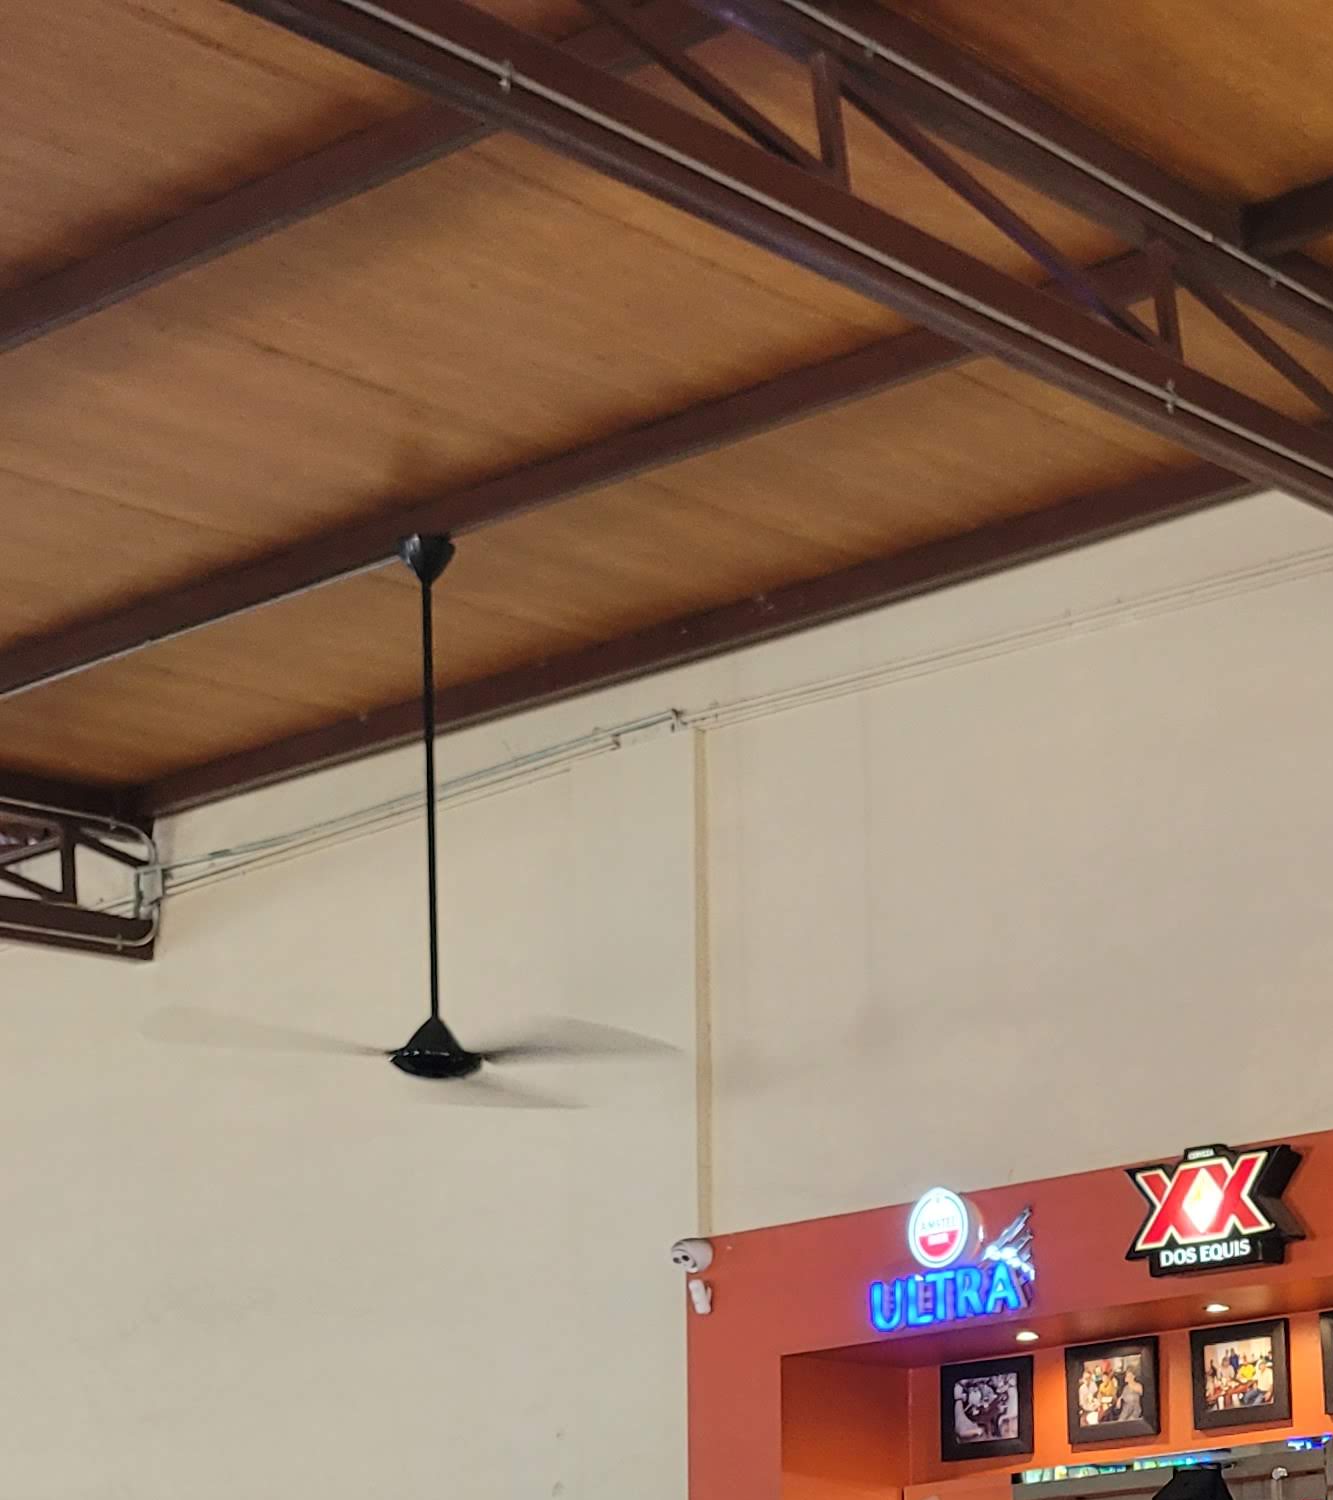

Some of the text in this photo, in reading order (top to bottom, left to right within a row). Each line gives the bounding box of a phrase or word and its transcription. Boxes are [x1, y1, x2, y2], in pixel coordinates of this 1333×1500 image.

[1134, 1151, 1273, 1252] XX
[1159, 1239, 1252, 1267] DOS EQUIS
[868, 1260, 1021, 1332] ULTRA
